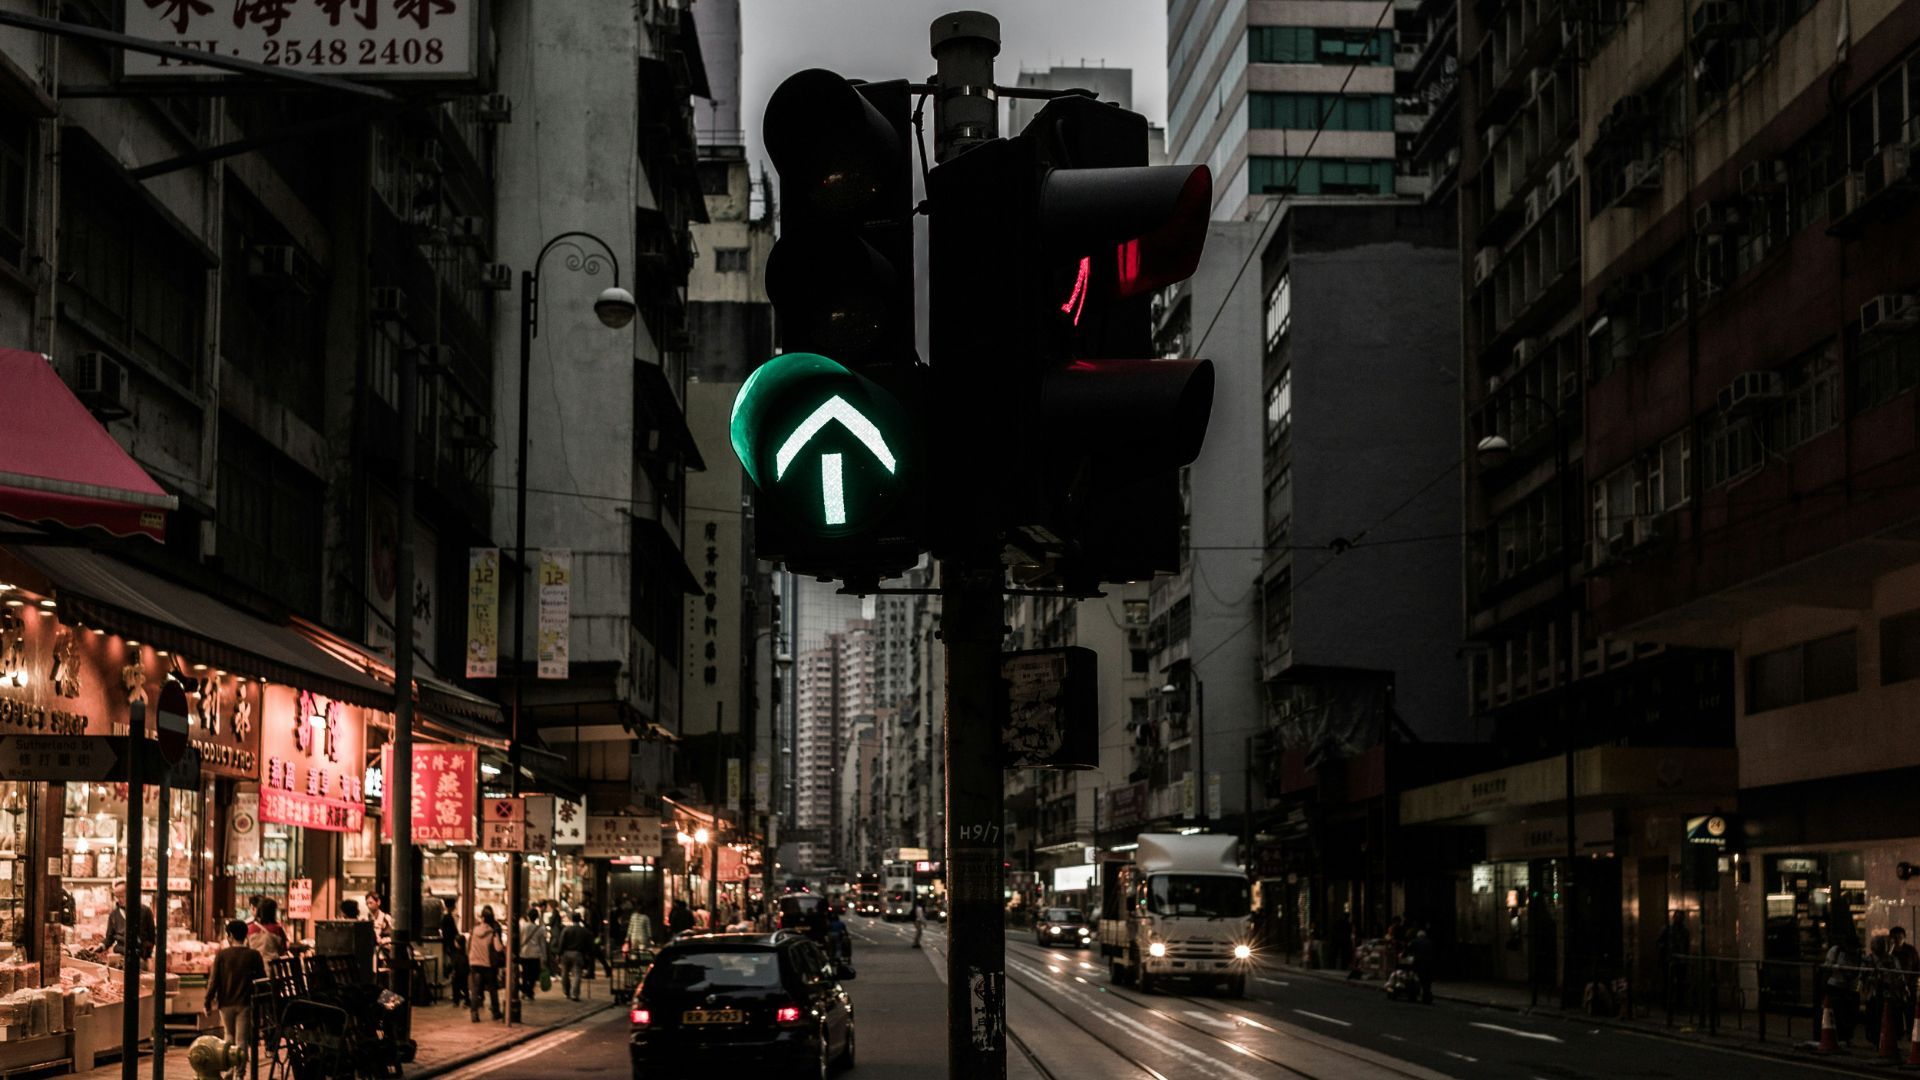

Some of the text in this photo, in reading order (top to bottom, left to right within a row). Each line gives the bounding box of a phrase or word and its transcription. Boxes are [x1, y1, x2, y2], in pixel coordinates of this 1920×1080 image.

[262, 39, 347, 66] 2548
[358, 38, 443, 65] 2408
[475, 568, 494, 583] 12
[545, 571, 564, 586] 12
[16, 739, 94, 751] Sutherland St
[495, 824, 513, 833] End
[1710, 819, 1721, 829] 24
[960, 820, 1000, 844] H9/7
